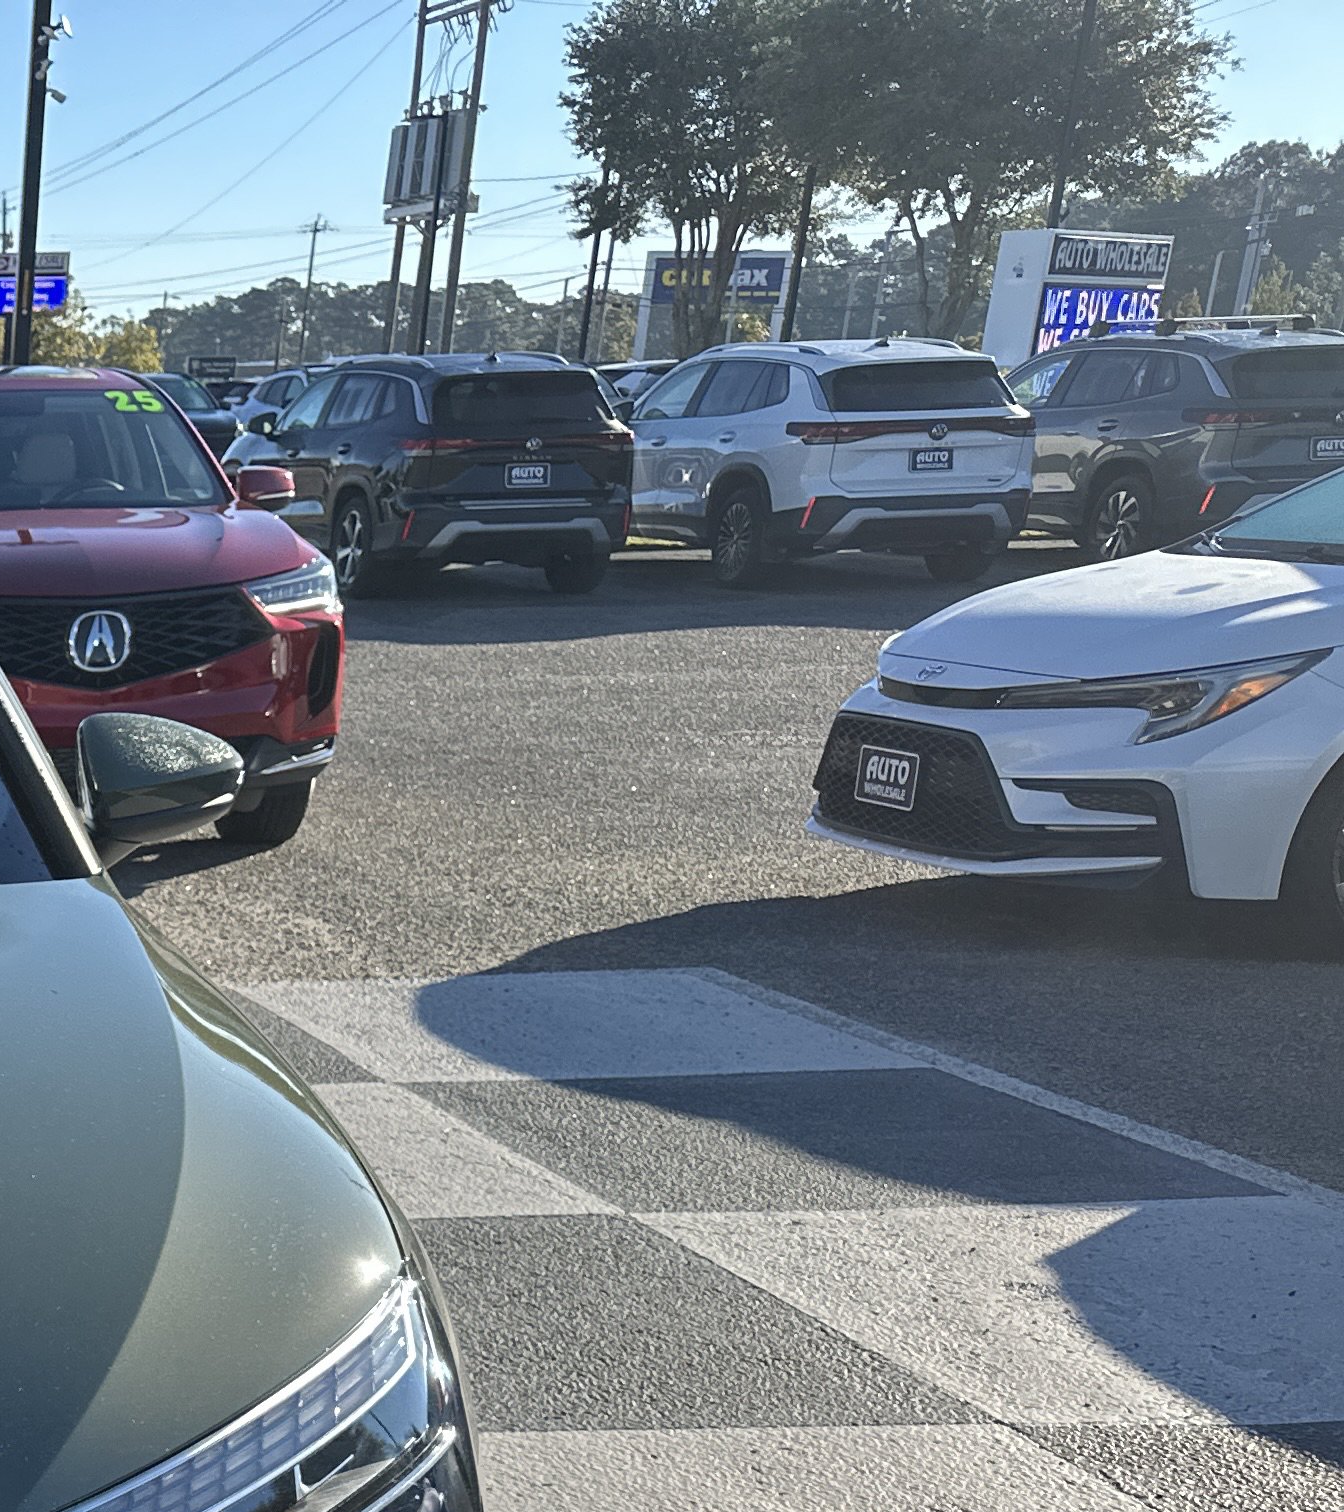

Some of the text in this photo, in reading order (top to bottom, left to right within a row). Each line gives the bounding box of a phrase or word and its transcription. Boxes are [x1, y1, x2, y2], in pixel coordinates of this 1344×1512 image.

[1056, 239, 1170, 274] AUTO WHOLESALE
[662, 267, 769, 287] carax
[1044, 289, 1160, 326] WE BUY CARS
[1038, 328, 1063, 354] WE
[104, 390, 164, 413] 25
[916, 451, 949, 463] AUTO
[511, 466, 544, 478] AUTO
[866, 755, 910, 785] AUTO
